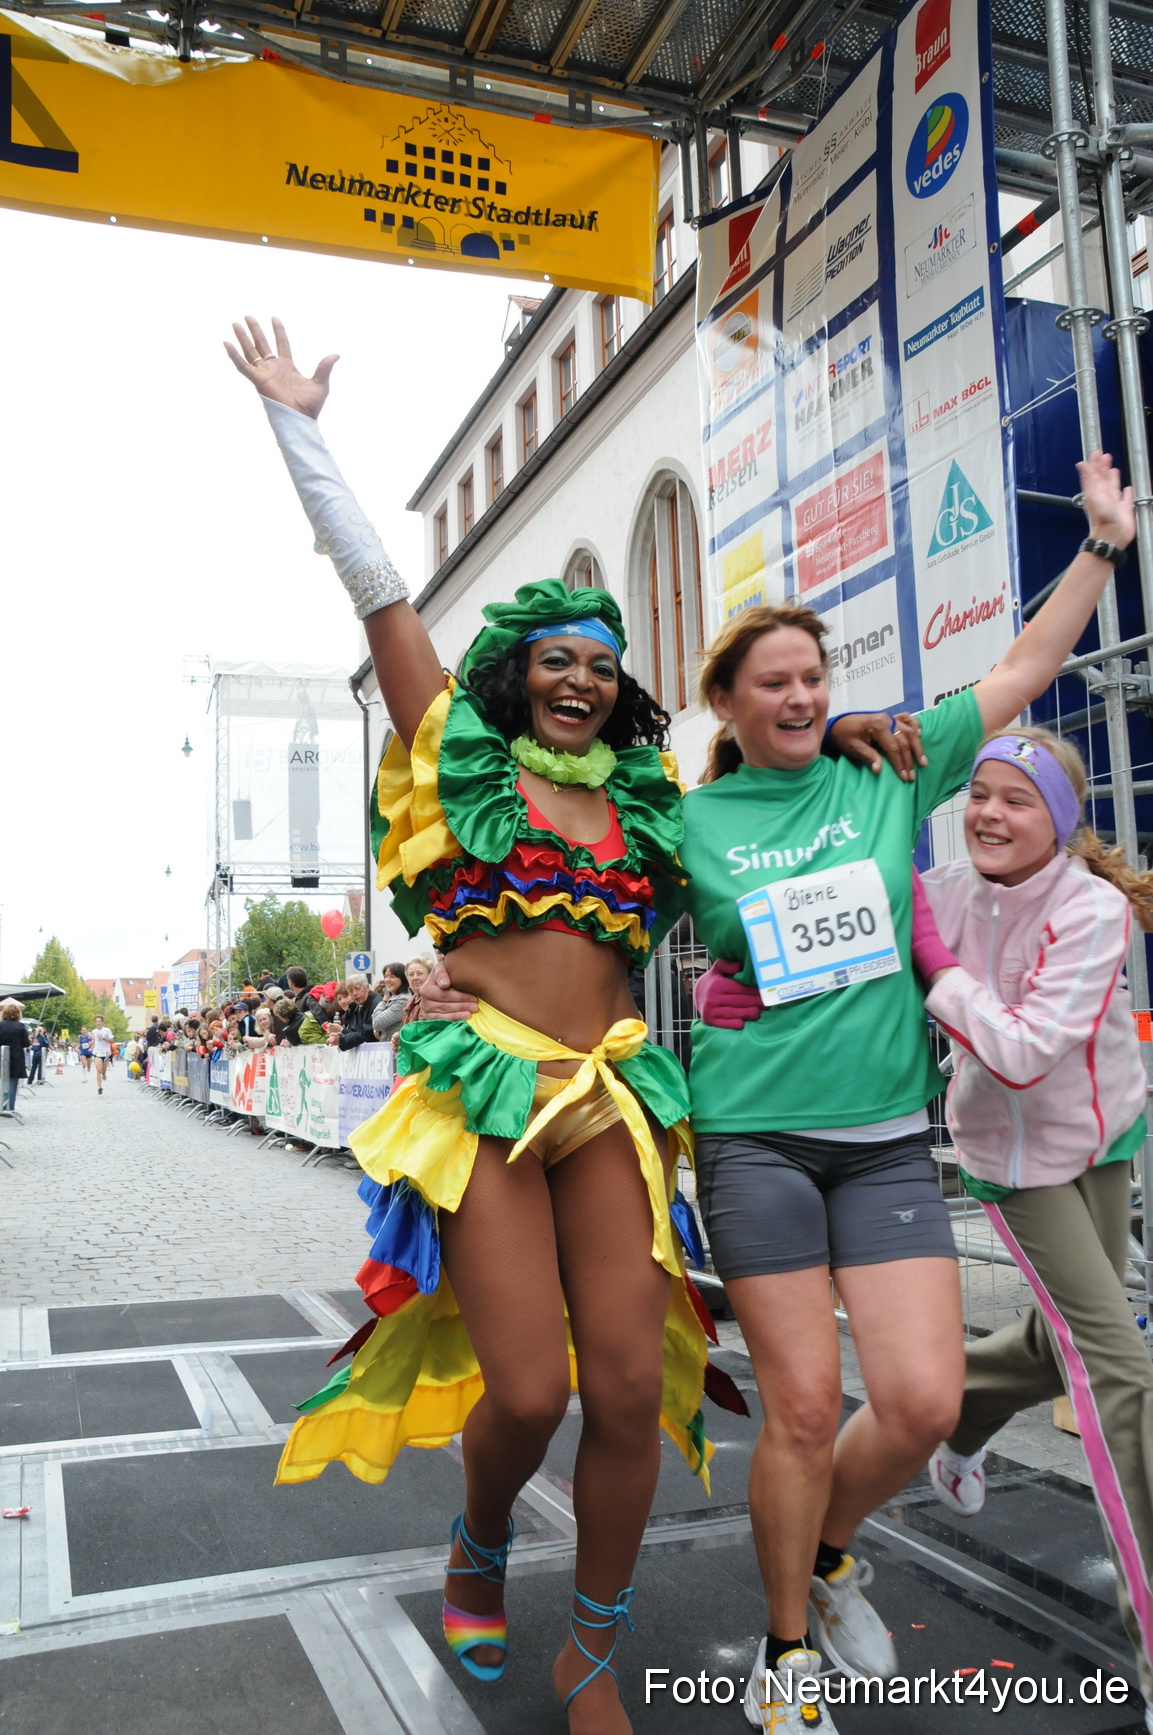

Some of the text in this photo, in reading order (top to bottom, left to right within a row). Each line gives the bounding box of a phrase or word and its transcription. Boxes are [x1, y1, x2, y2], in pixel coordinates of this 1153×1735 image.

[915, 27, 947, 75] Braun
[914, 143, 960, 194] vedes
[285, 162, 599, 231] Neumarkter Stadtlauf
[825, 239, 865, 284] PEDITION
[827, 213, 871, 264] Wagner
[914, 228, 966, 282] NEUMARKTER
[906, 295, 981, 356] Neumarkter Tagblatt
[805, 334, 872, 401] INTRSPORT
[933, 376, 992, 420] MAX BÖGL
[708, 418, 772, 489] MERZ
[803, 468, 874, 527] GUT FÜR SIE!
[923, 581, 1006, 650] Charivari
[791, 906, 877, 953] 3550
